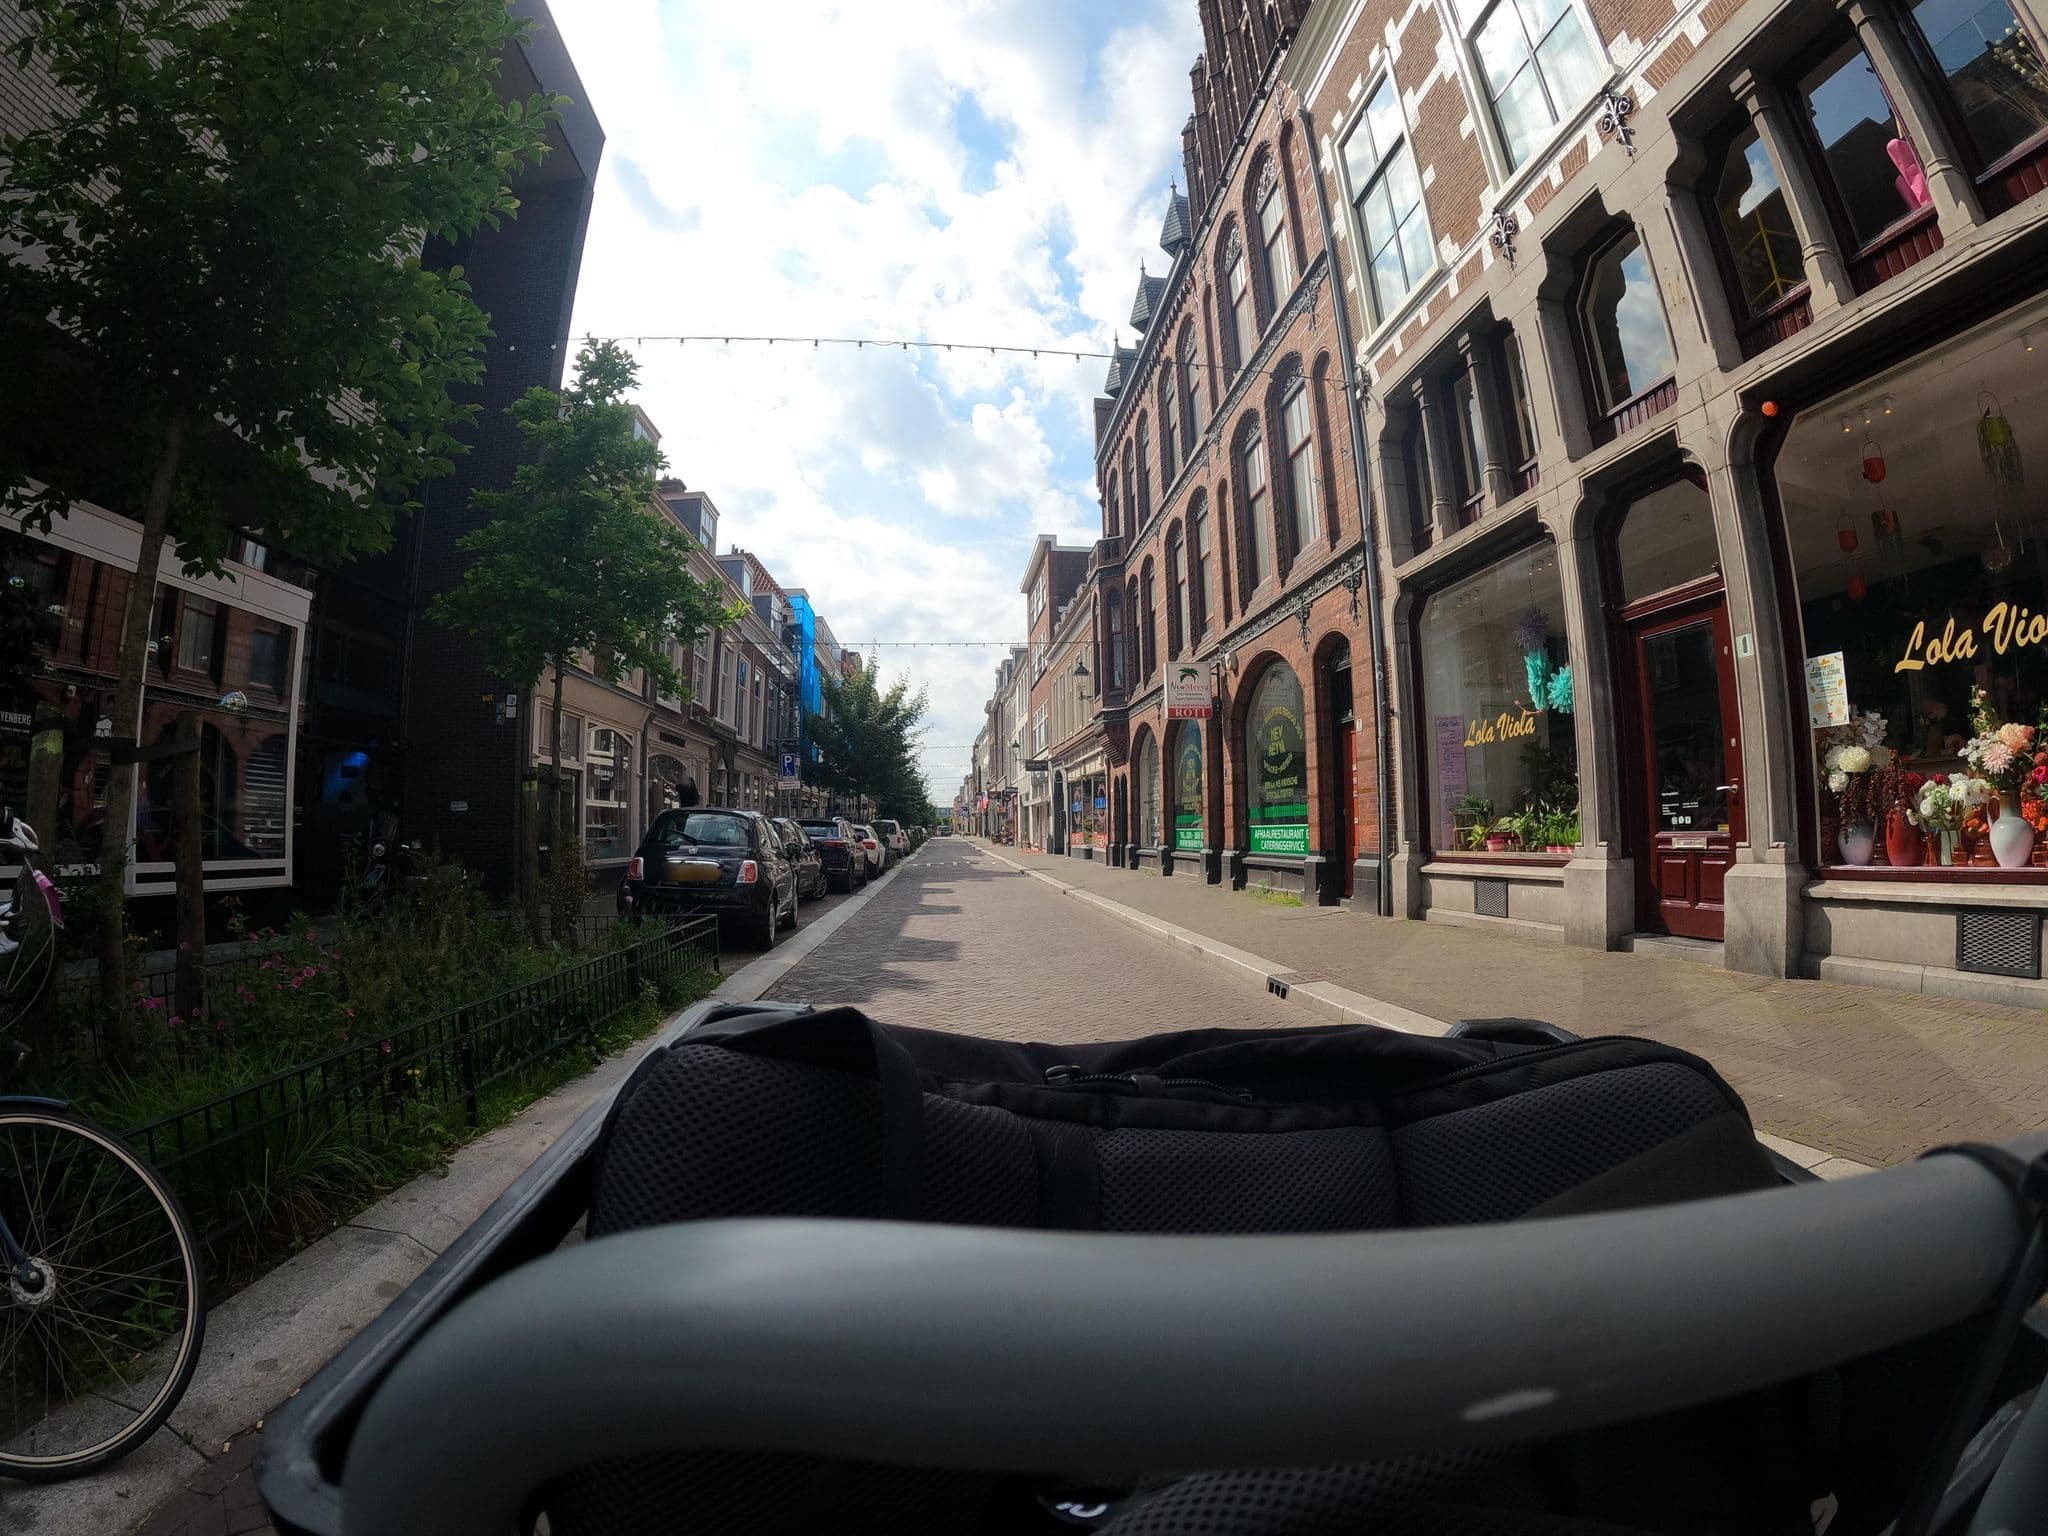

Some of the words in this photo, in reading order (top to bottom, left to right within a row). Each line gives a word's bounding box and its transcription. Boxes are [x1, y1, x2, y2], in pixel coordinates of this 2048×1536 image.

[1894, 616, 1979, 674] Lola
[1983, 601, 2048, 656] Vio
[1175, 708, 1205, 717] ROTI
[1463, 719, 1496, 747] Lola
[1496, 710, 1536, 741] Viola
[784, 755, 793, 768] P
[1254, 828, 1305, 839] AFHAALRESTAURANT
[1260, 840, 1305, 851] CATERINGSERVICE
